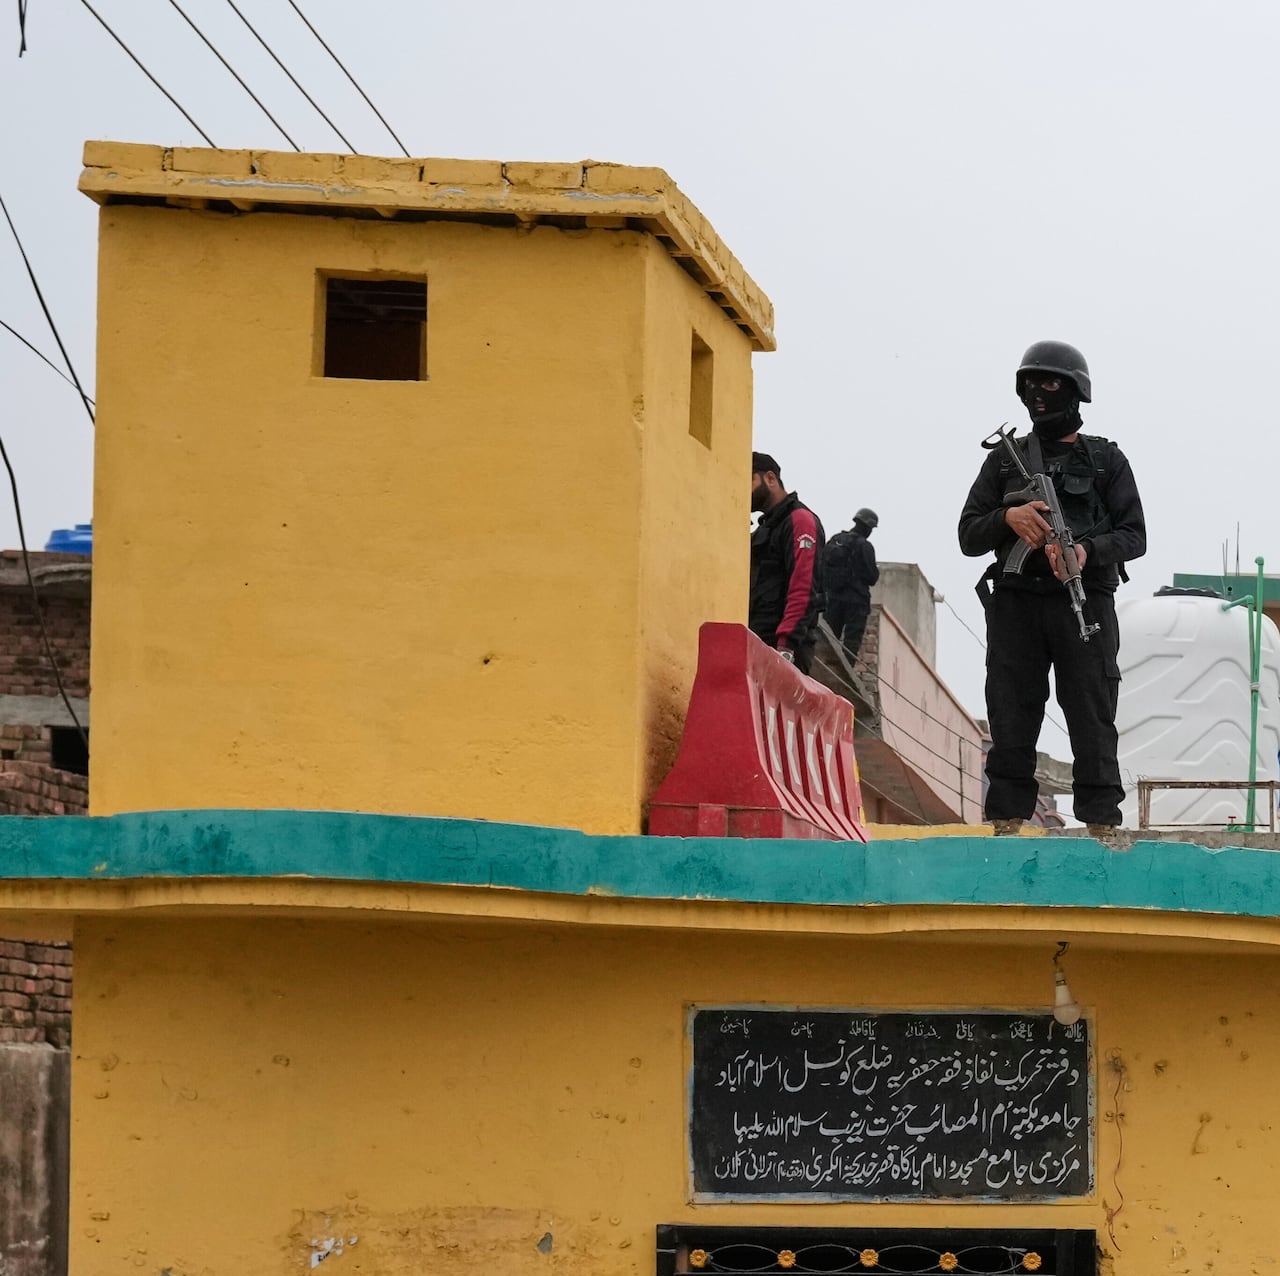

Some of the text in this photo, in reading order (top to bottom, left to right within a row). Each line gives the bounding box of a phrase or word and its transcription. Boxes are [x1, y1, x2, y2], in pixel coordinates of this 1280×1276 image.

[715, 1050, 749, 1092] آباد
[783, 1039, 864, 1092] کونسل
[852, 1044, 893, 1096] ضلع
[887, 1056, 940, 1098] جعفریہ
[1045, 1048, 1080, 1094] دفتر
[764, 1110, 784, 1137] اللہ
[785, 1110, 828, 1143] سلام
[818, 1104, 873, 1144] زینب
[866, 1104, 918, 1144] حضرت
[904, 1098, 987, 1142] المصائب
[891, 1145, 921, 1186] بارگاہ
[920, 1152, 947, 1191] امام
[950, 1148, 988, 1186] مسجد
[985, 1148, 1029, 1189] جامع
[1029, 1144, 1082, 1187] مرکزی
